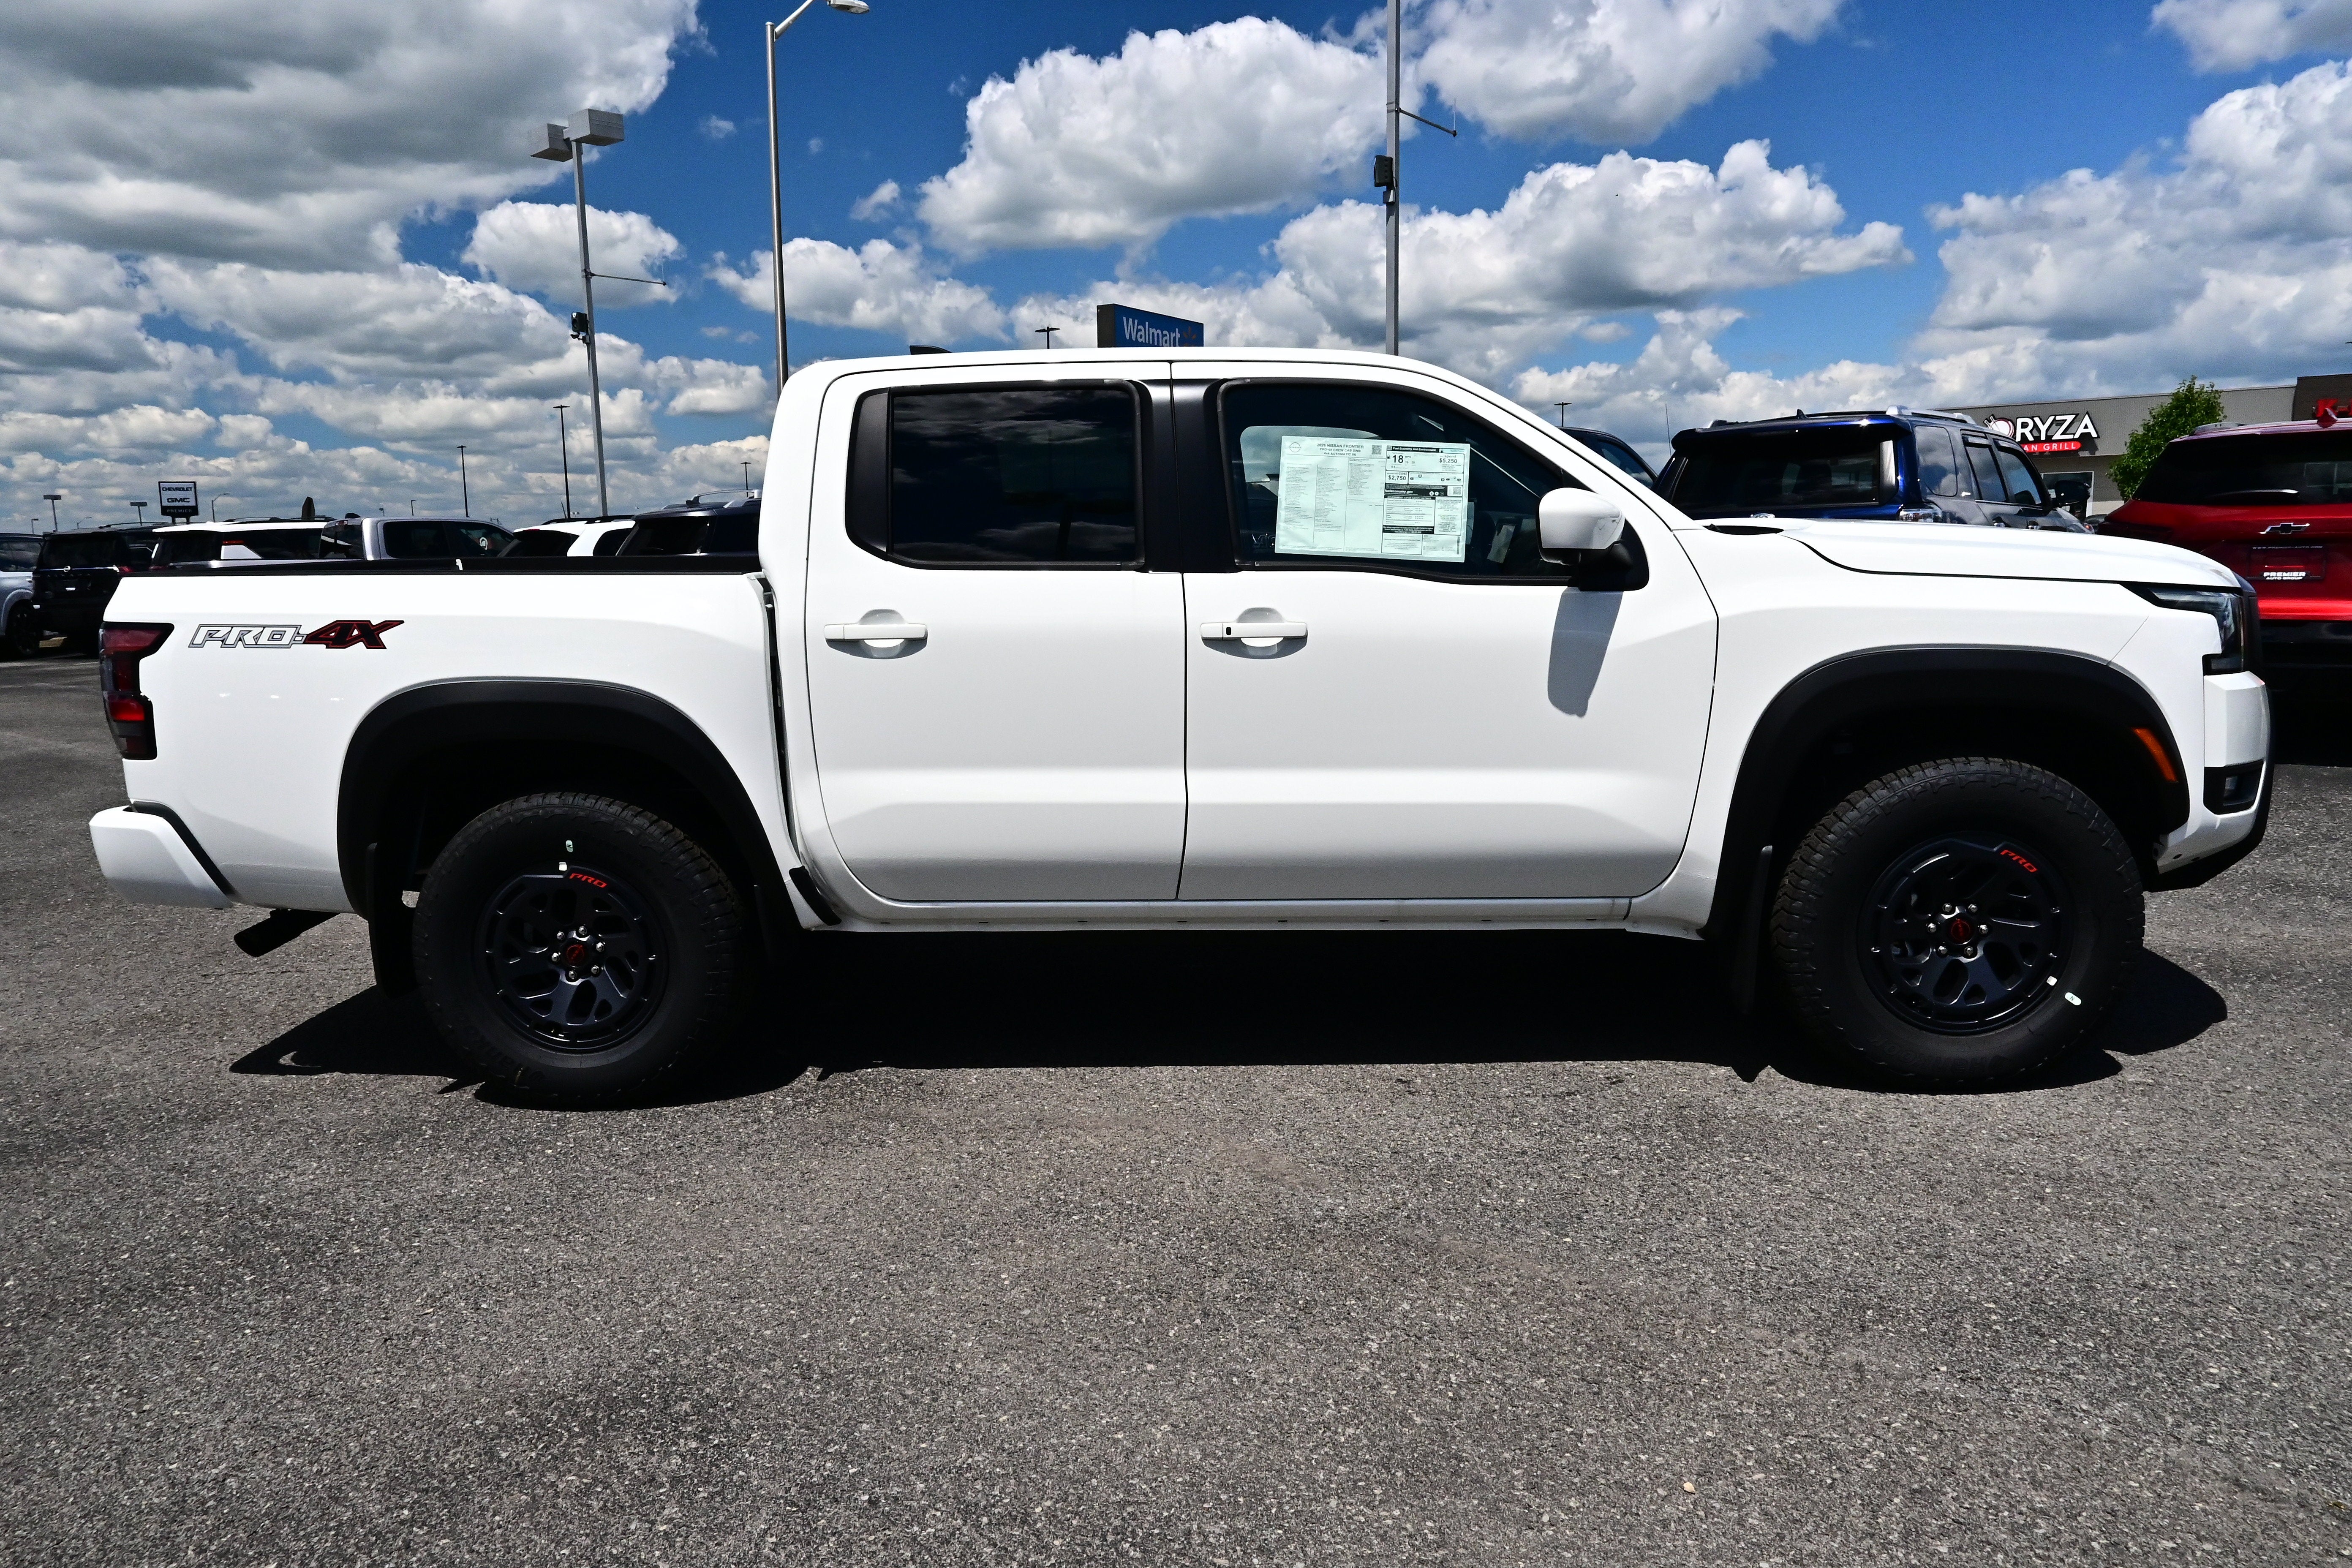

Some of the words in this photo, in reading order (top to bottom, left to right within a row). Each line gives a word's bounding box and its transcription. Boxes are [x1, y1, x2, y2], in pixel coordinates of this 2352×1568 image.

[1123, 316, 1180, 347] Walmart
[2043, 442, 2076, 450] GRILL
[1392, 455, 1403, 463] 18
[2000, 849, 2037, 873] PRO
[569, 873, 607, 888] PRO
